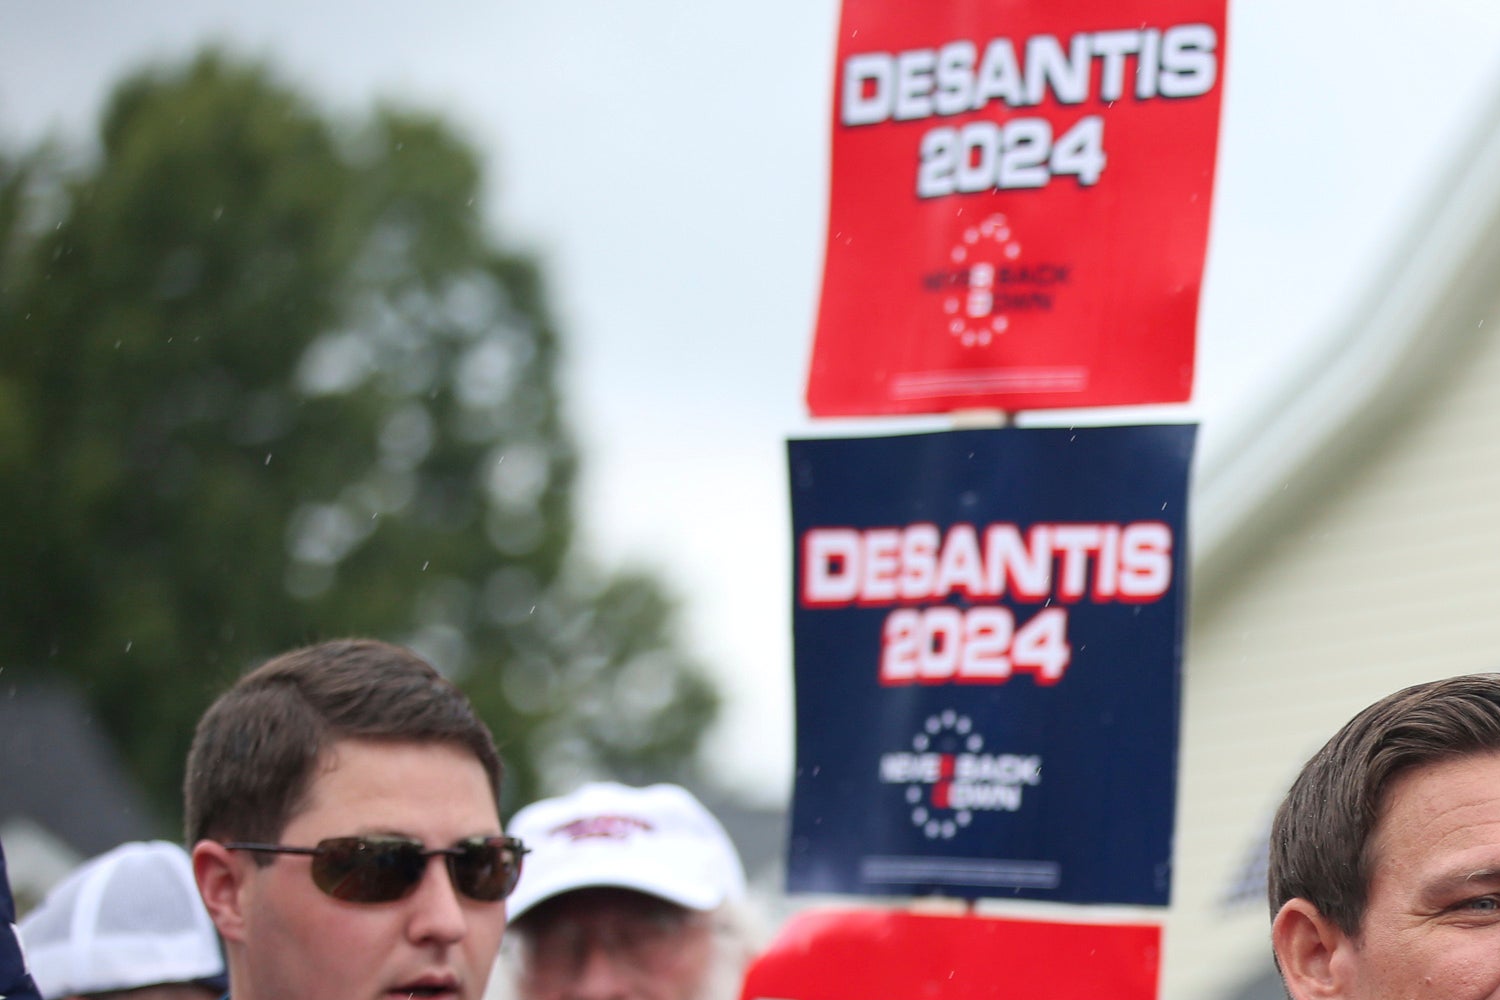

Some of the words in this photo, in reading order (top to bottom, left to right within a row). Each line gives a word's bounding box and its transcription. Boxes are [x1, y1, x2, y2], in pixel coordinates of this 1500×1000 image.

[840, 22, 1218, 127] DESANTIS
[917, 115, 1107, 203] 2024
[801, 521, 1173, 608] DESANTIS
[879, 604, 1071, 687] 2024
